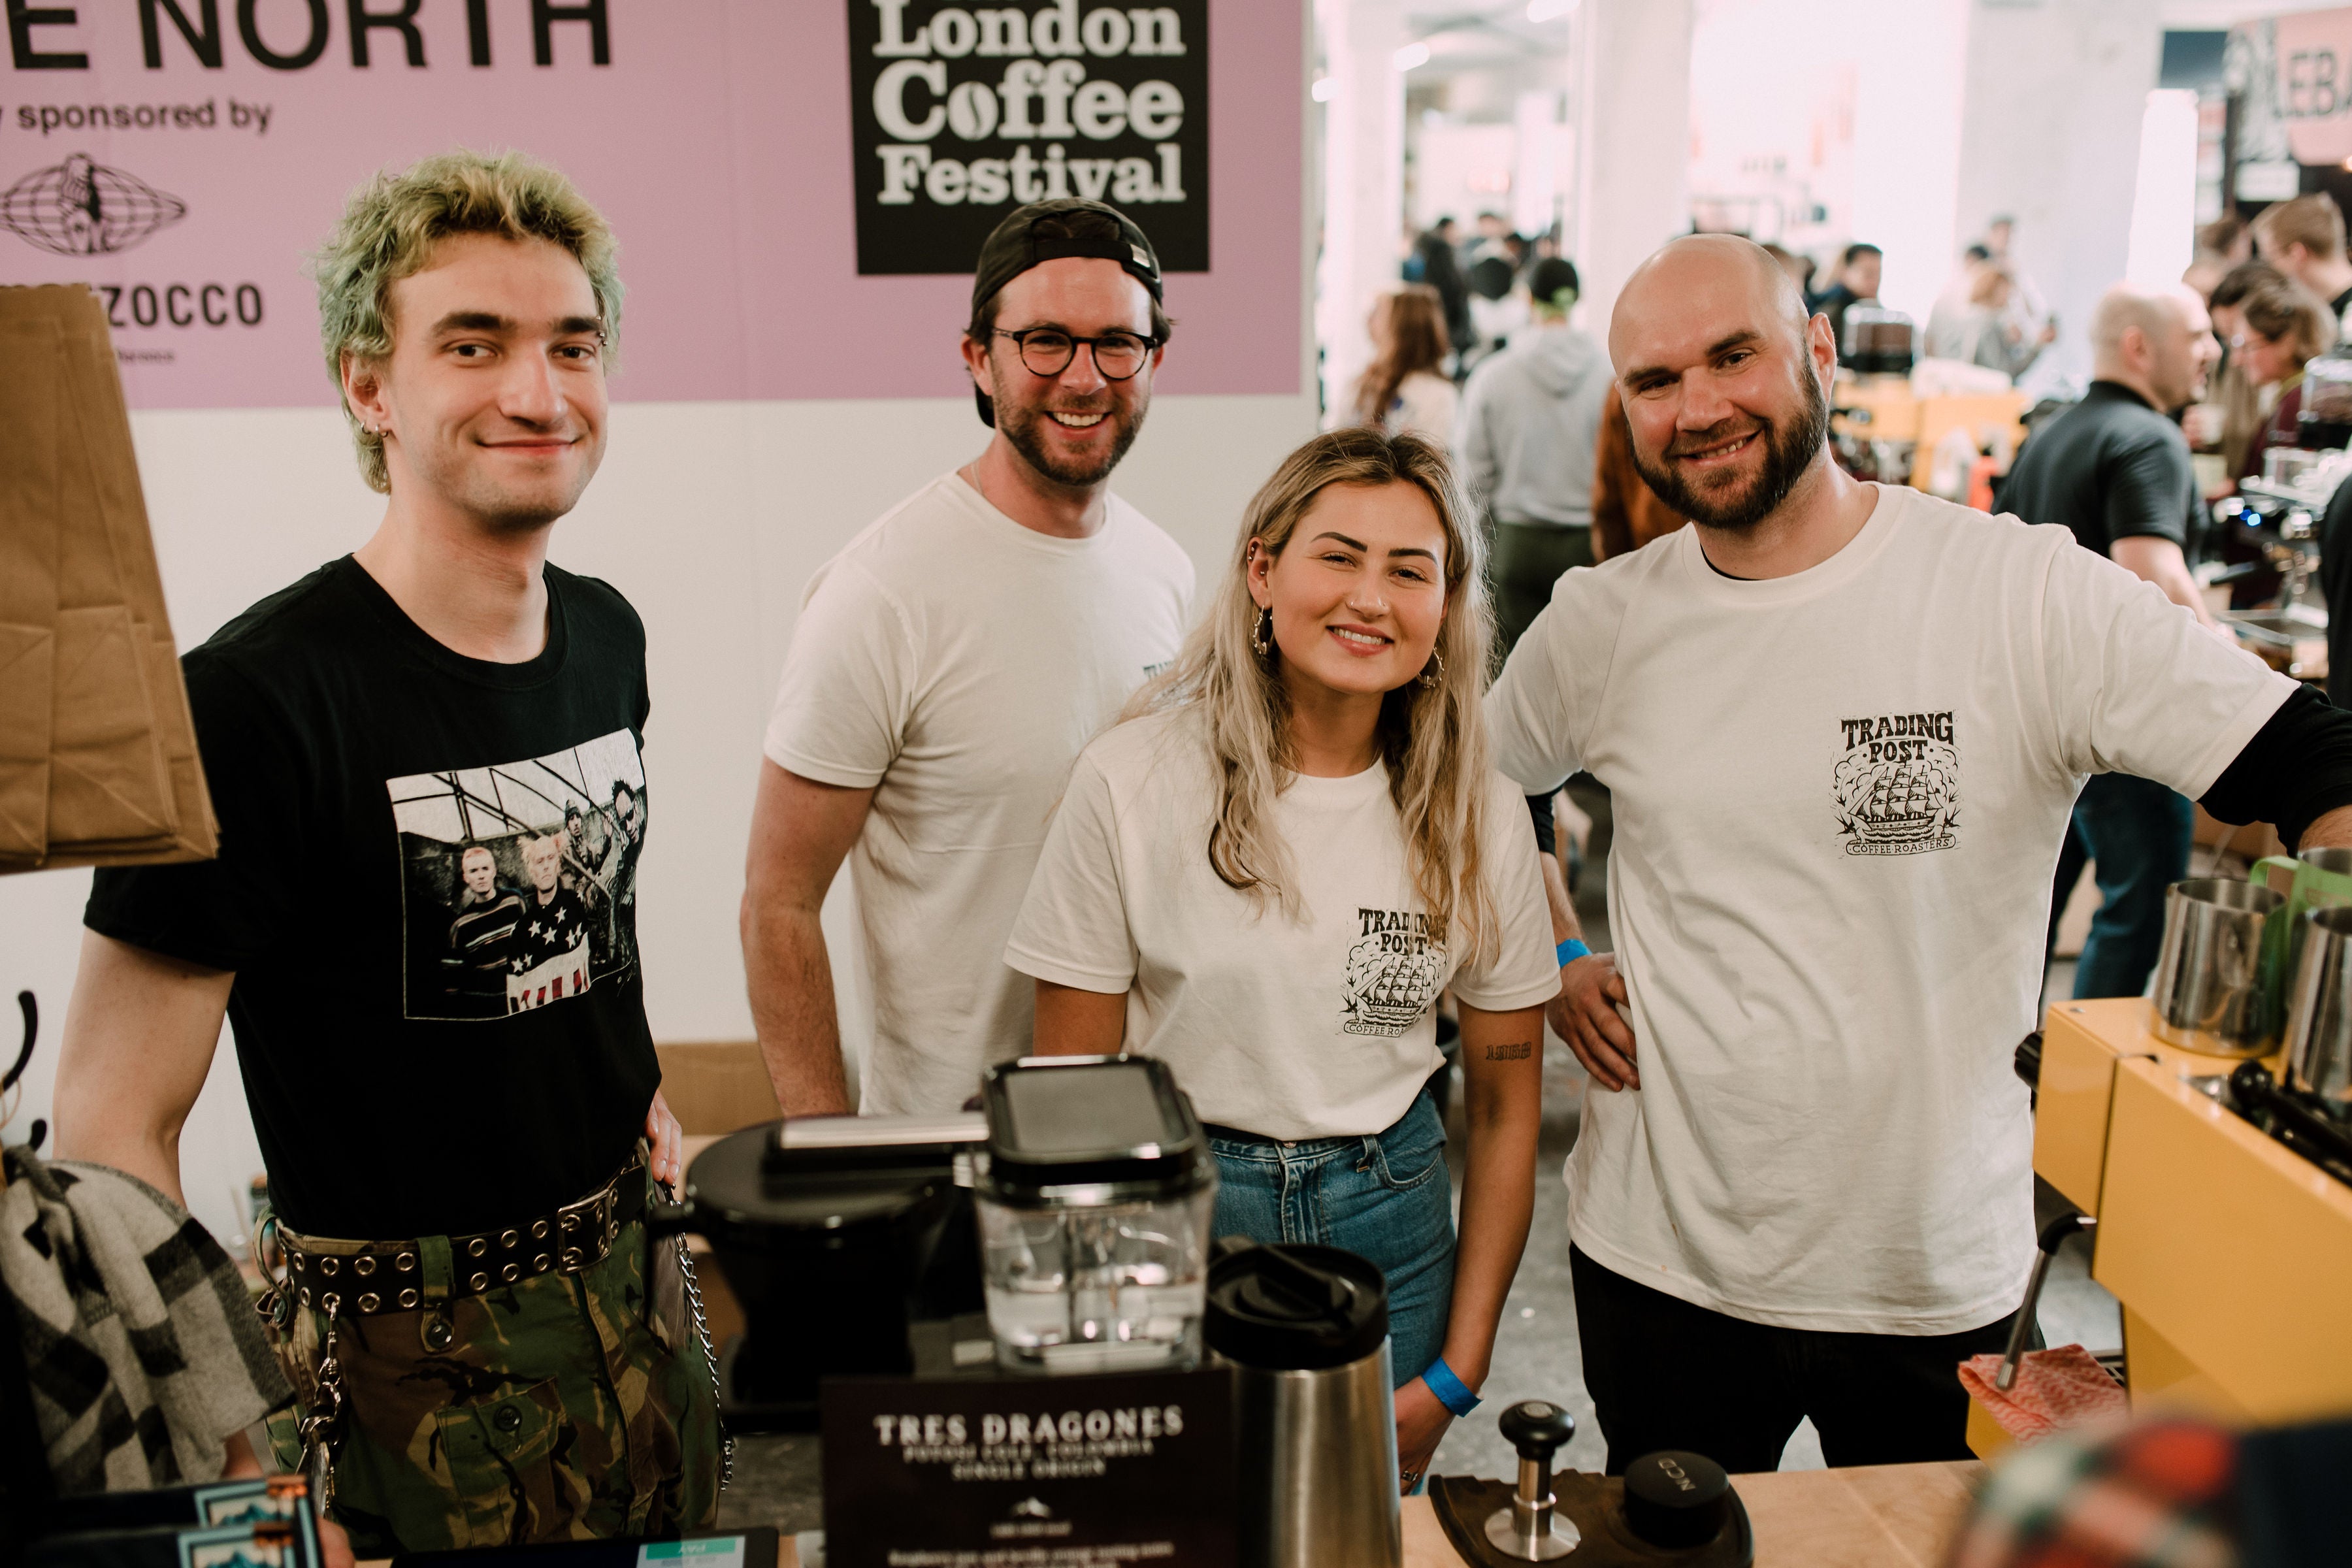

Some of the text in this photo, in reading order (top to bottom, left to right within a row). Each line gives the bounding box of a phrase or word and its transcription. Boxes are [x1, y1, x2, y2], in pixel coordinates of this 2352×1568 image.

[139, 0, 612, 71] NORTH
[872, 0, 1187, 57] London
[18, 98, 217, 135] sponsored
[229, 98, 272, 135] by
[872, 59, 1185, 142] Coffee
[875, 142, 1187, 205] Festival
[100, 284, 263, 327] ZOCCO
[1840, 711, 1954, 751] TRADING
[1869, 740, 1928, 763] POST
[1852, 839, 1950, 853] COFFEE ROASTERS
[1349, 1024, 1385, 1035] COFFEE
[873, 1404, 1184, 1446] TRES DRAGONES
